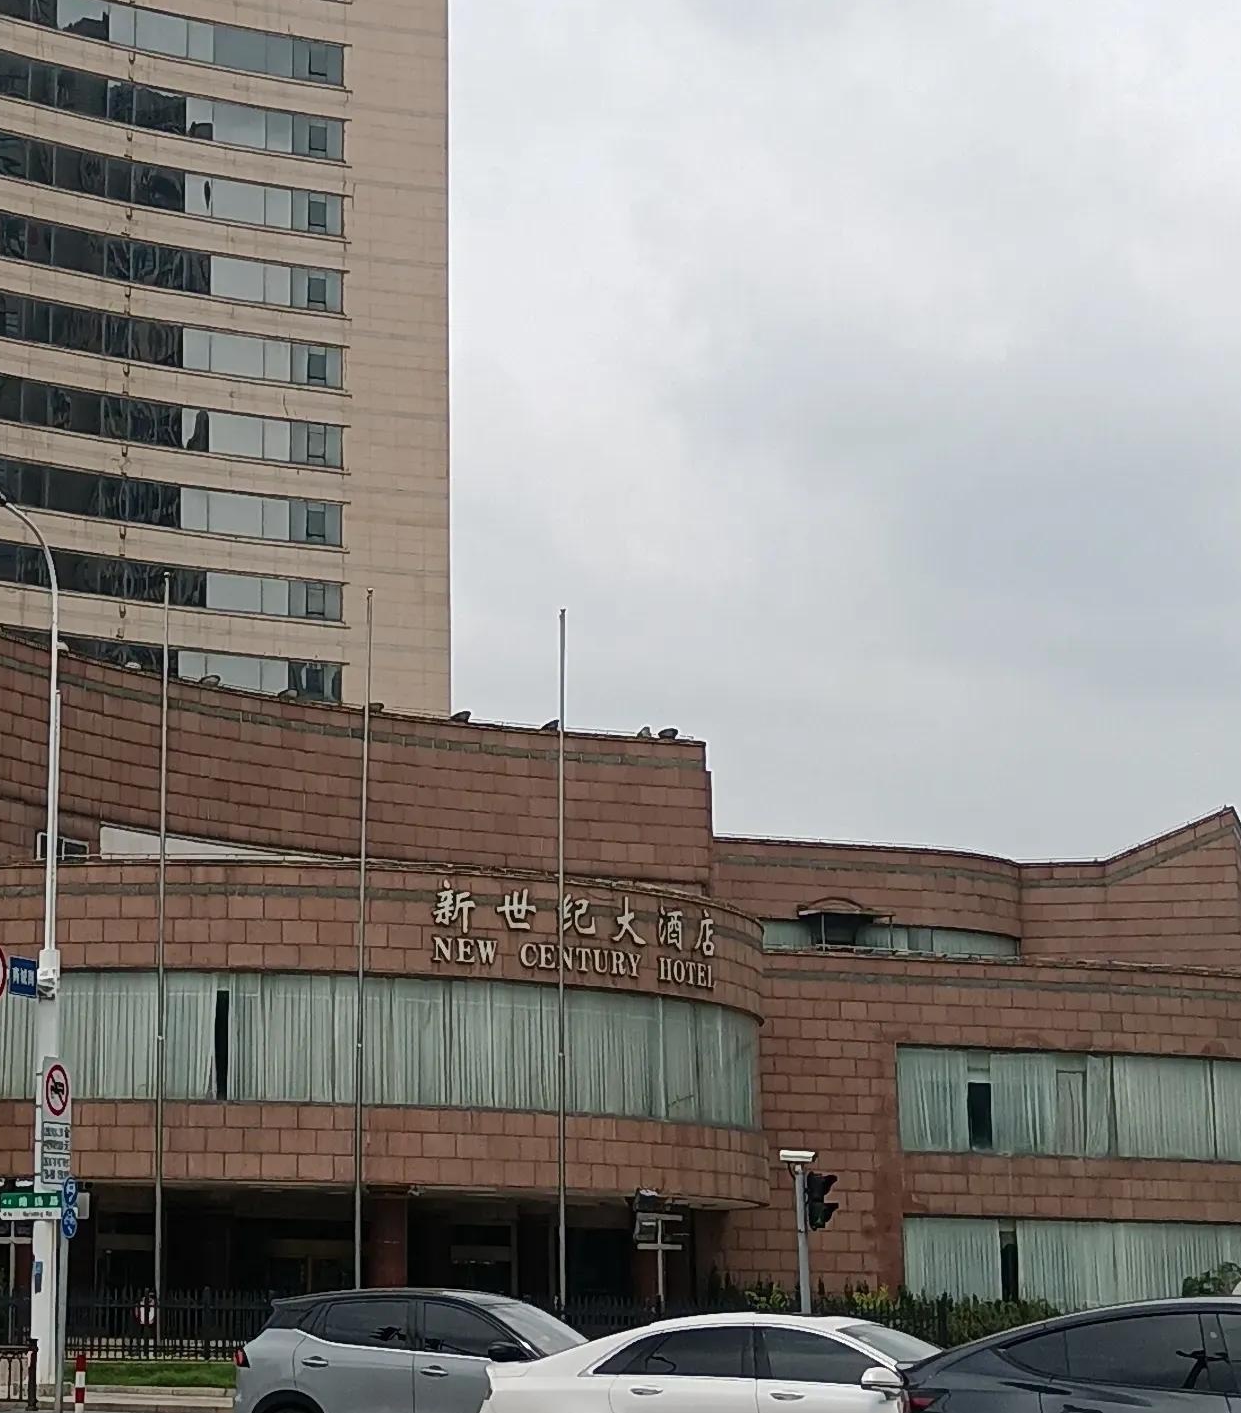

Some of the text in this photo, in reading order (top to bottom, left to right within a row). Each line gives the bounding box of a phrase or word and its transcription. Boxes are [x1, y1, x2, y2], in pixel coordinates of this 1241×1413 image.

[433, 879, 715, 956] 新世纪大酒店
[432, 936, 716, 988] NEW CENTURY HOTEL
